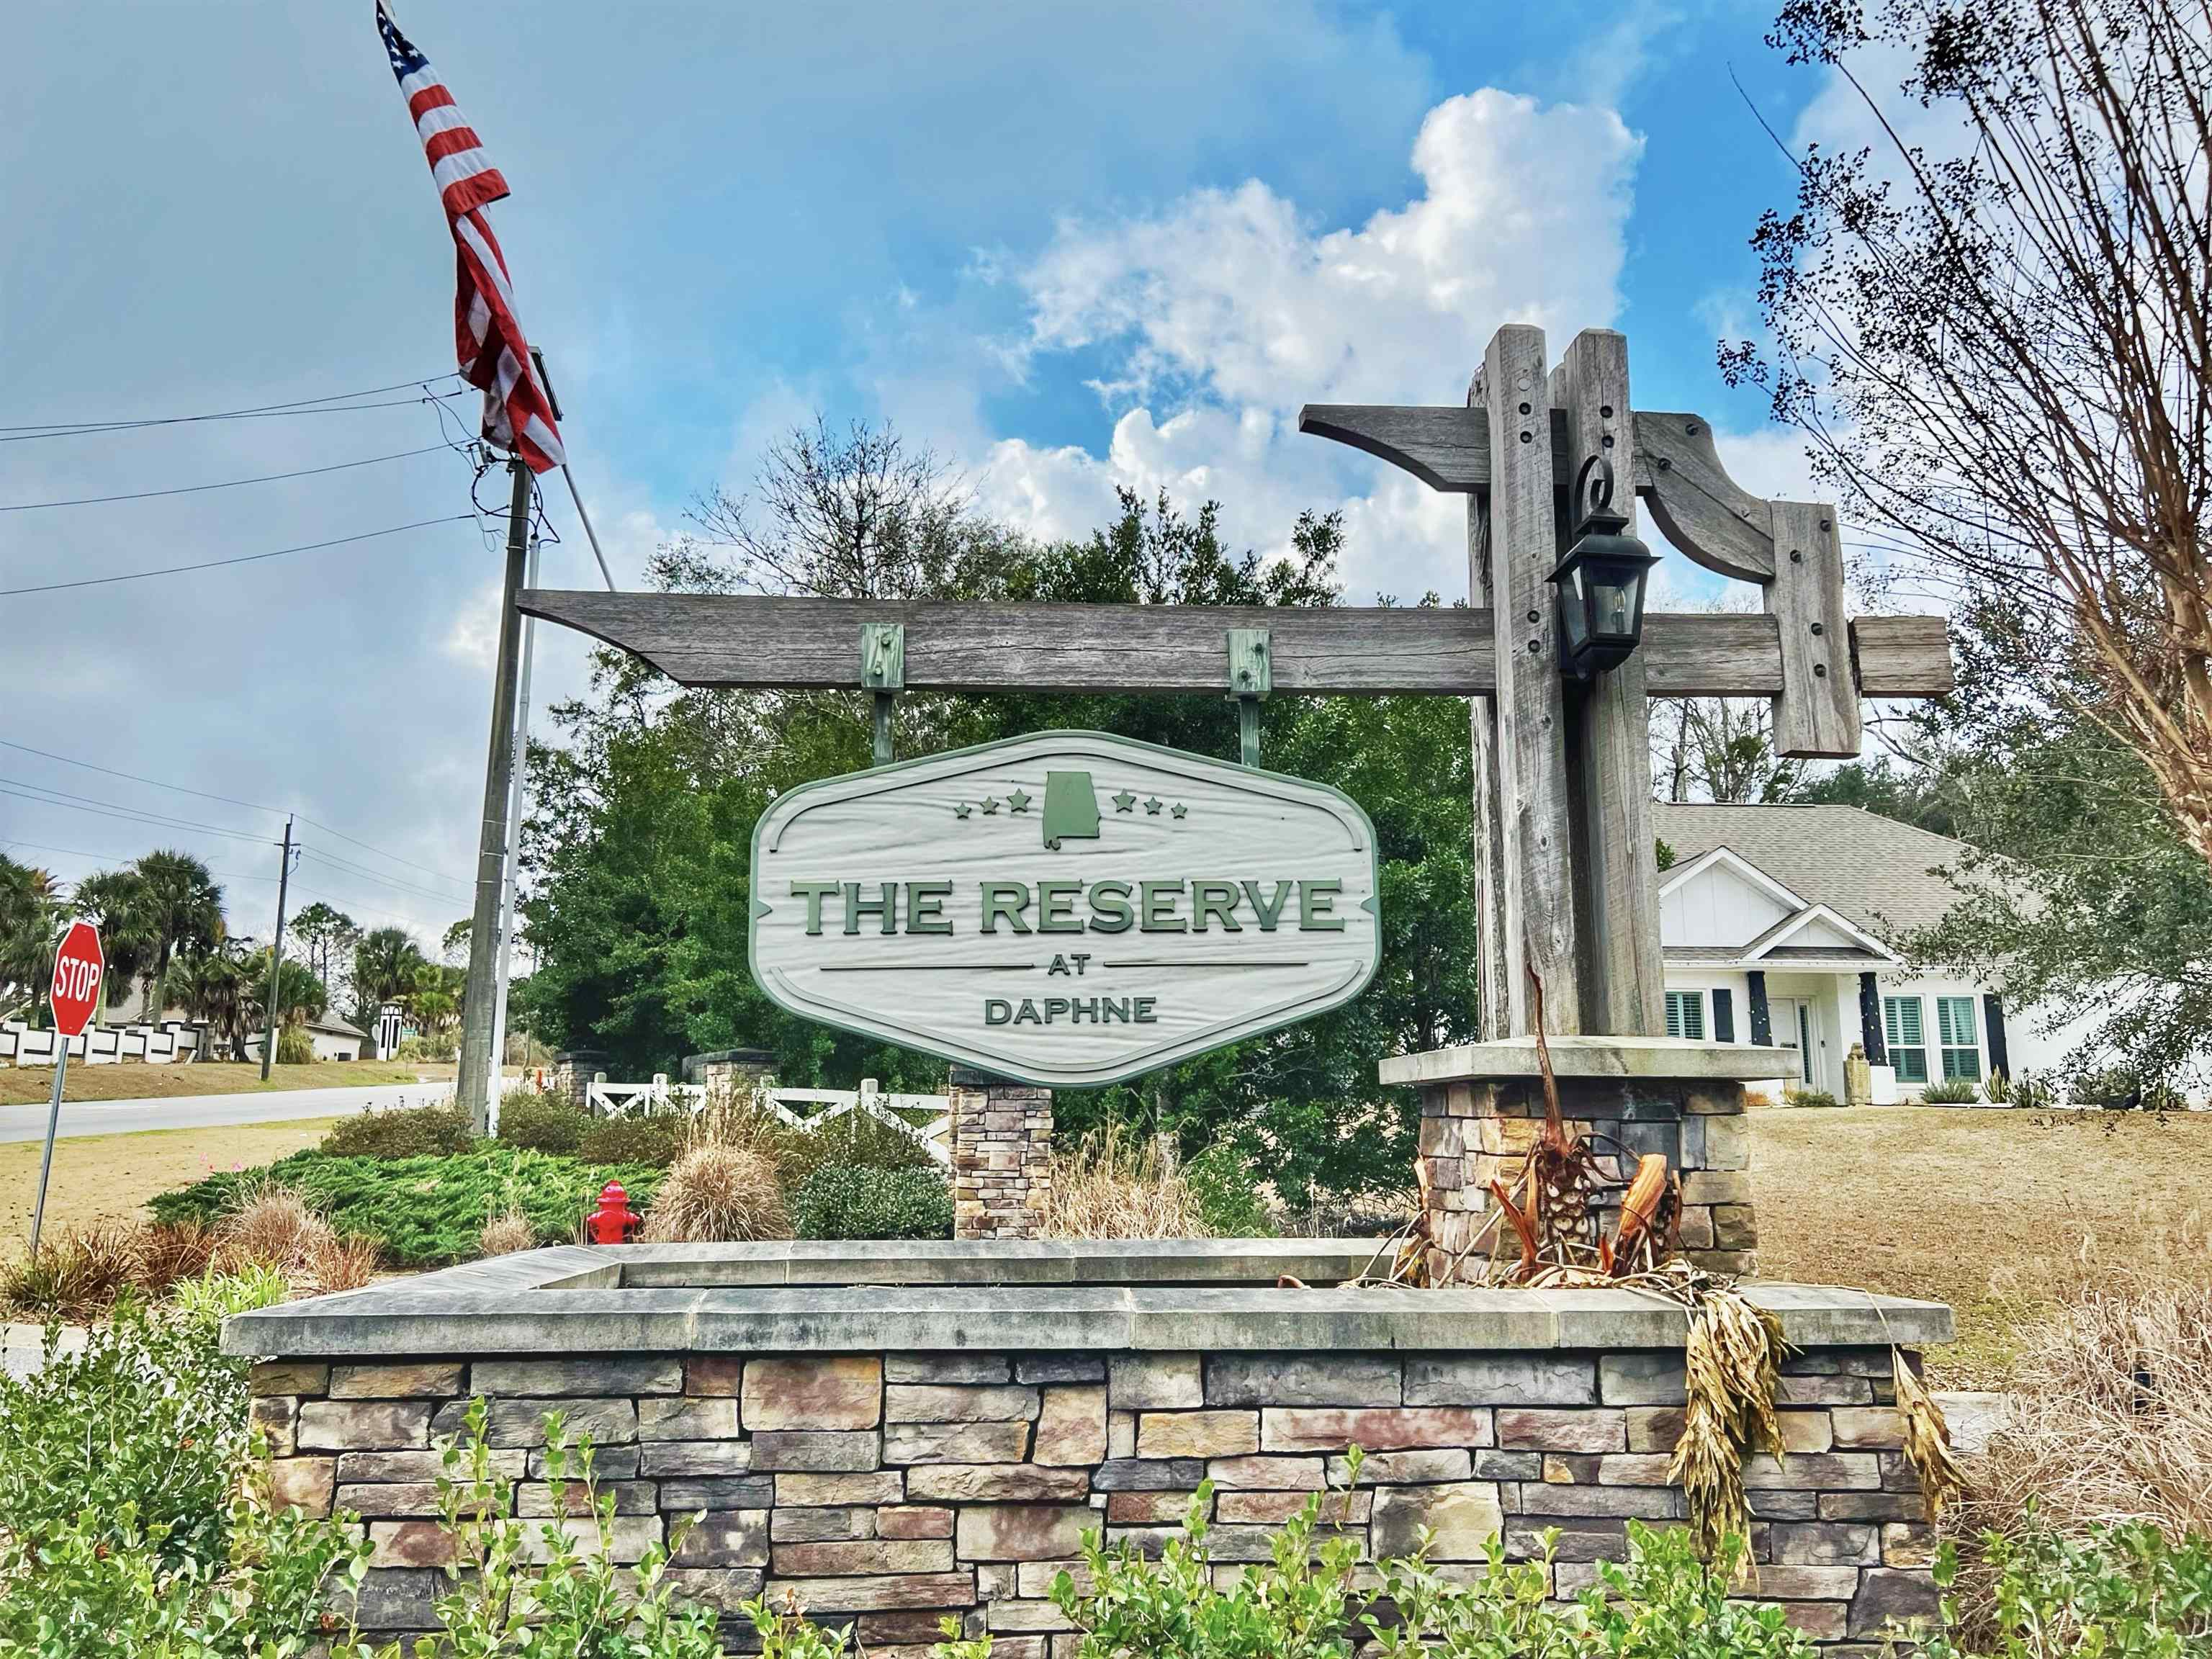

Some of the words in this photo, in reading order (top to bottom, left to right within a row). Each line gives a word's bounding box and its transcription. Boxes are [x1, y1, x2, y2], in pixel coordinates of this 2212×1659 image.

[791, 880, 953, 936] THE
[979, 878, 1345, 935] RESERVE
[55, 956, 100, 1002] STOP
[1048, 953, 1091, 976] AT
[985, 997, 1158, 1025] DAPHNE
